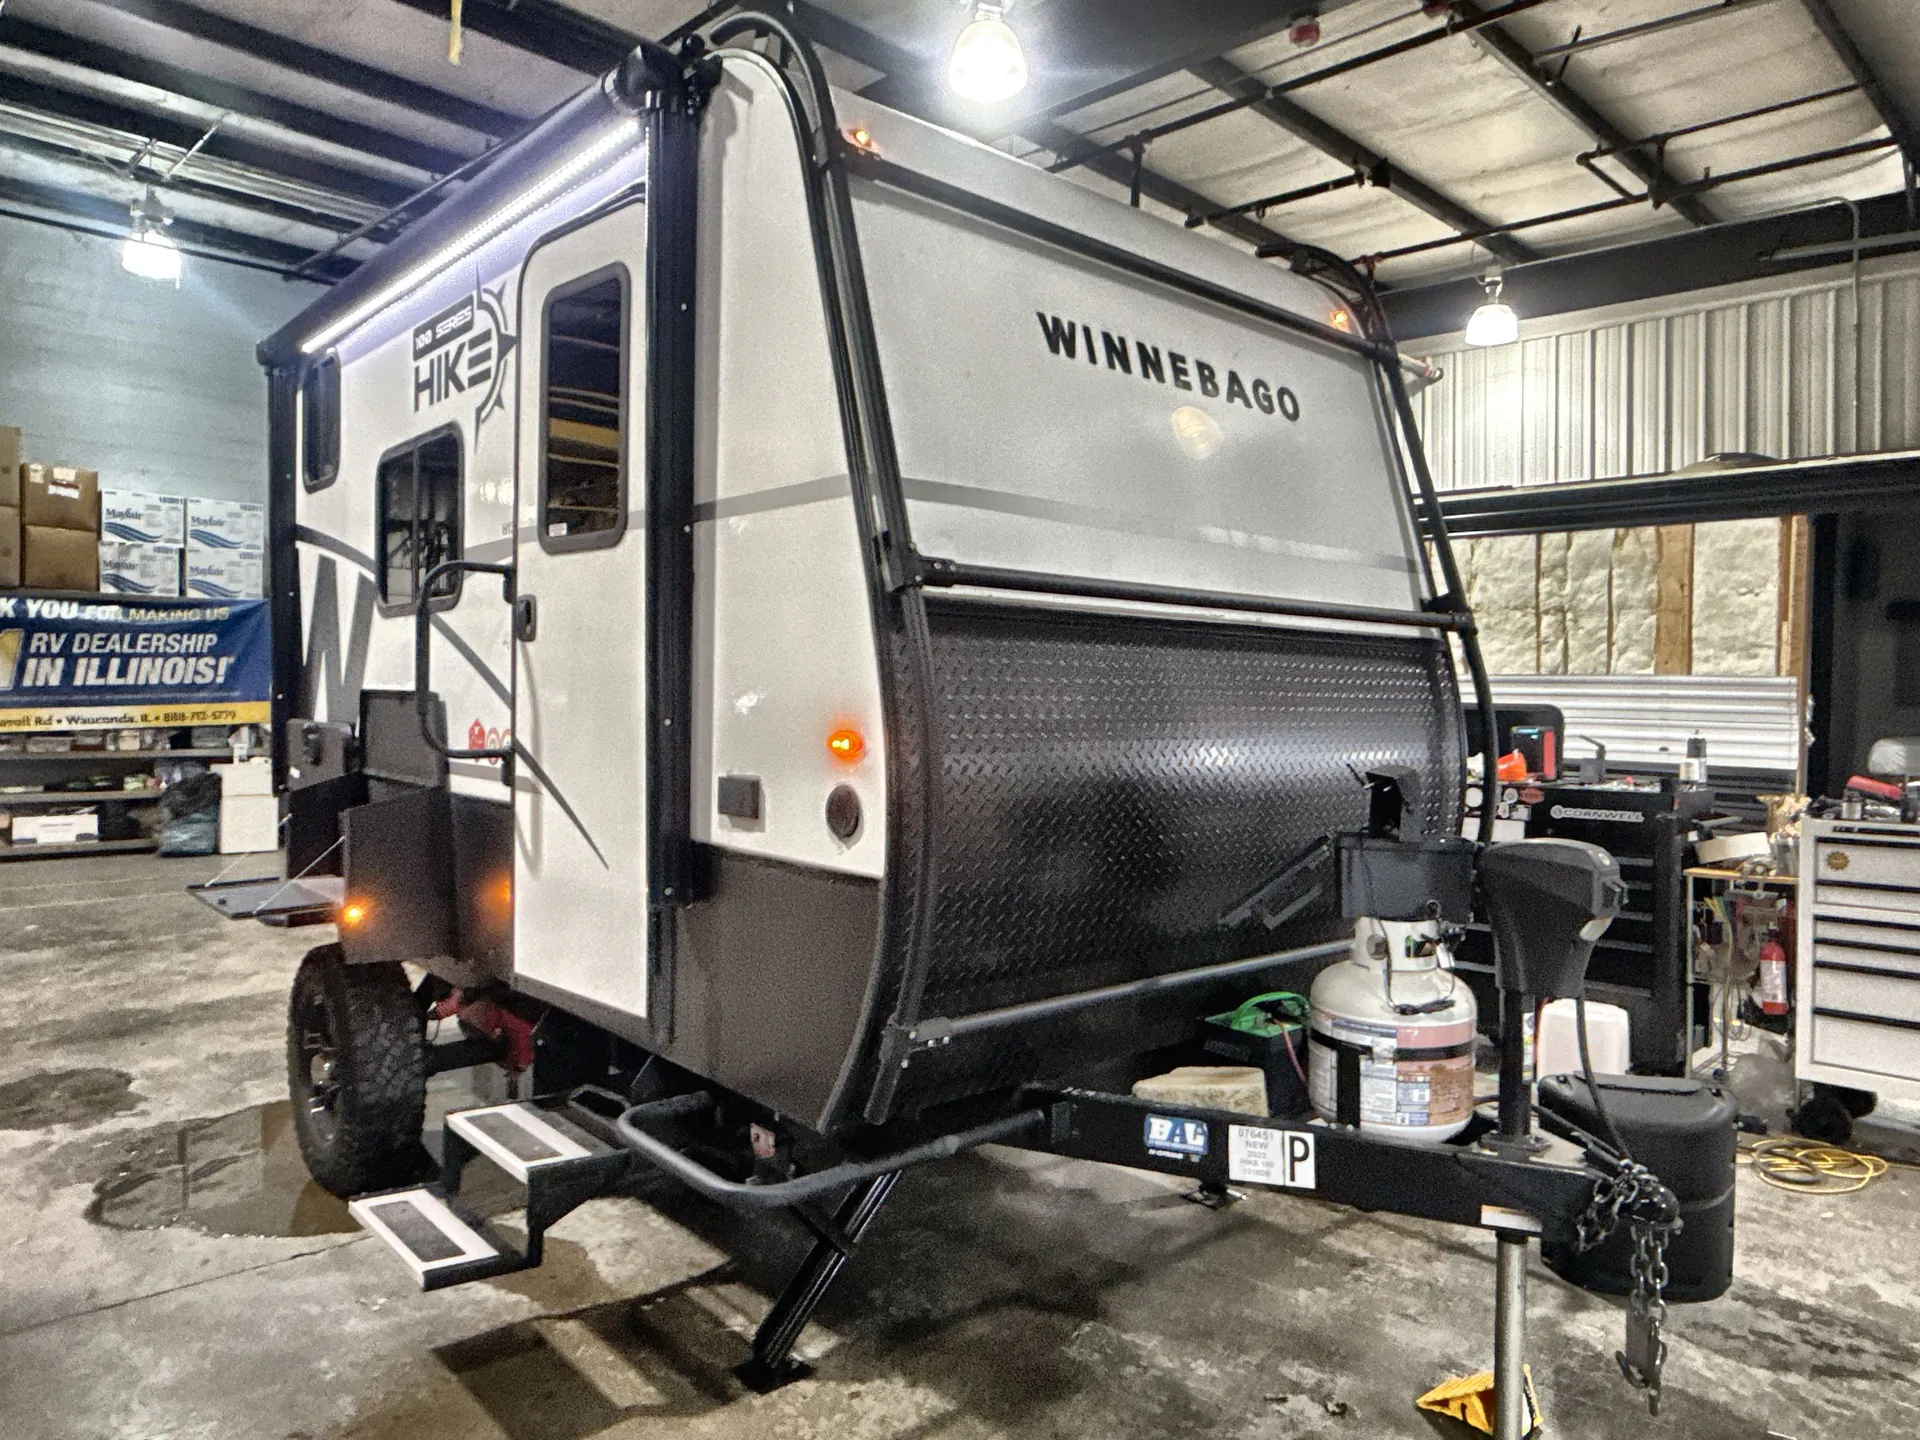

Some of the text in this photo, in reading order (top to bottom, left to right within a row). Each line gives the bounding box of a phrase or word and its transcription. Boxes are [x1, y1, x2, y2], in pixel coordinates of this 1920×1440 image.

[435, 305, 472, 339] SERIES
[414, 328, 492, 412] HIKE
[1036, 311, 1301, 422] WINNEBAGO
[105, 507, 142, 520] Mayfair
[25, 599, 79, 620] YOU
[128, 608, 202, 621] MAKING
[207, 607, 231, 621] US
[29, 632, 218, 654] RV DEALERSHIP
[22, 658, 65, 688] IN
[1563, 807, 1642, 820] CORNWELL
[1245, 1140, 1269, 1150] NEW
[1289, 1135, 1310, 1182] P
